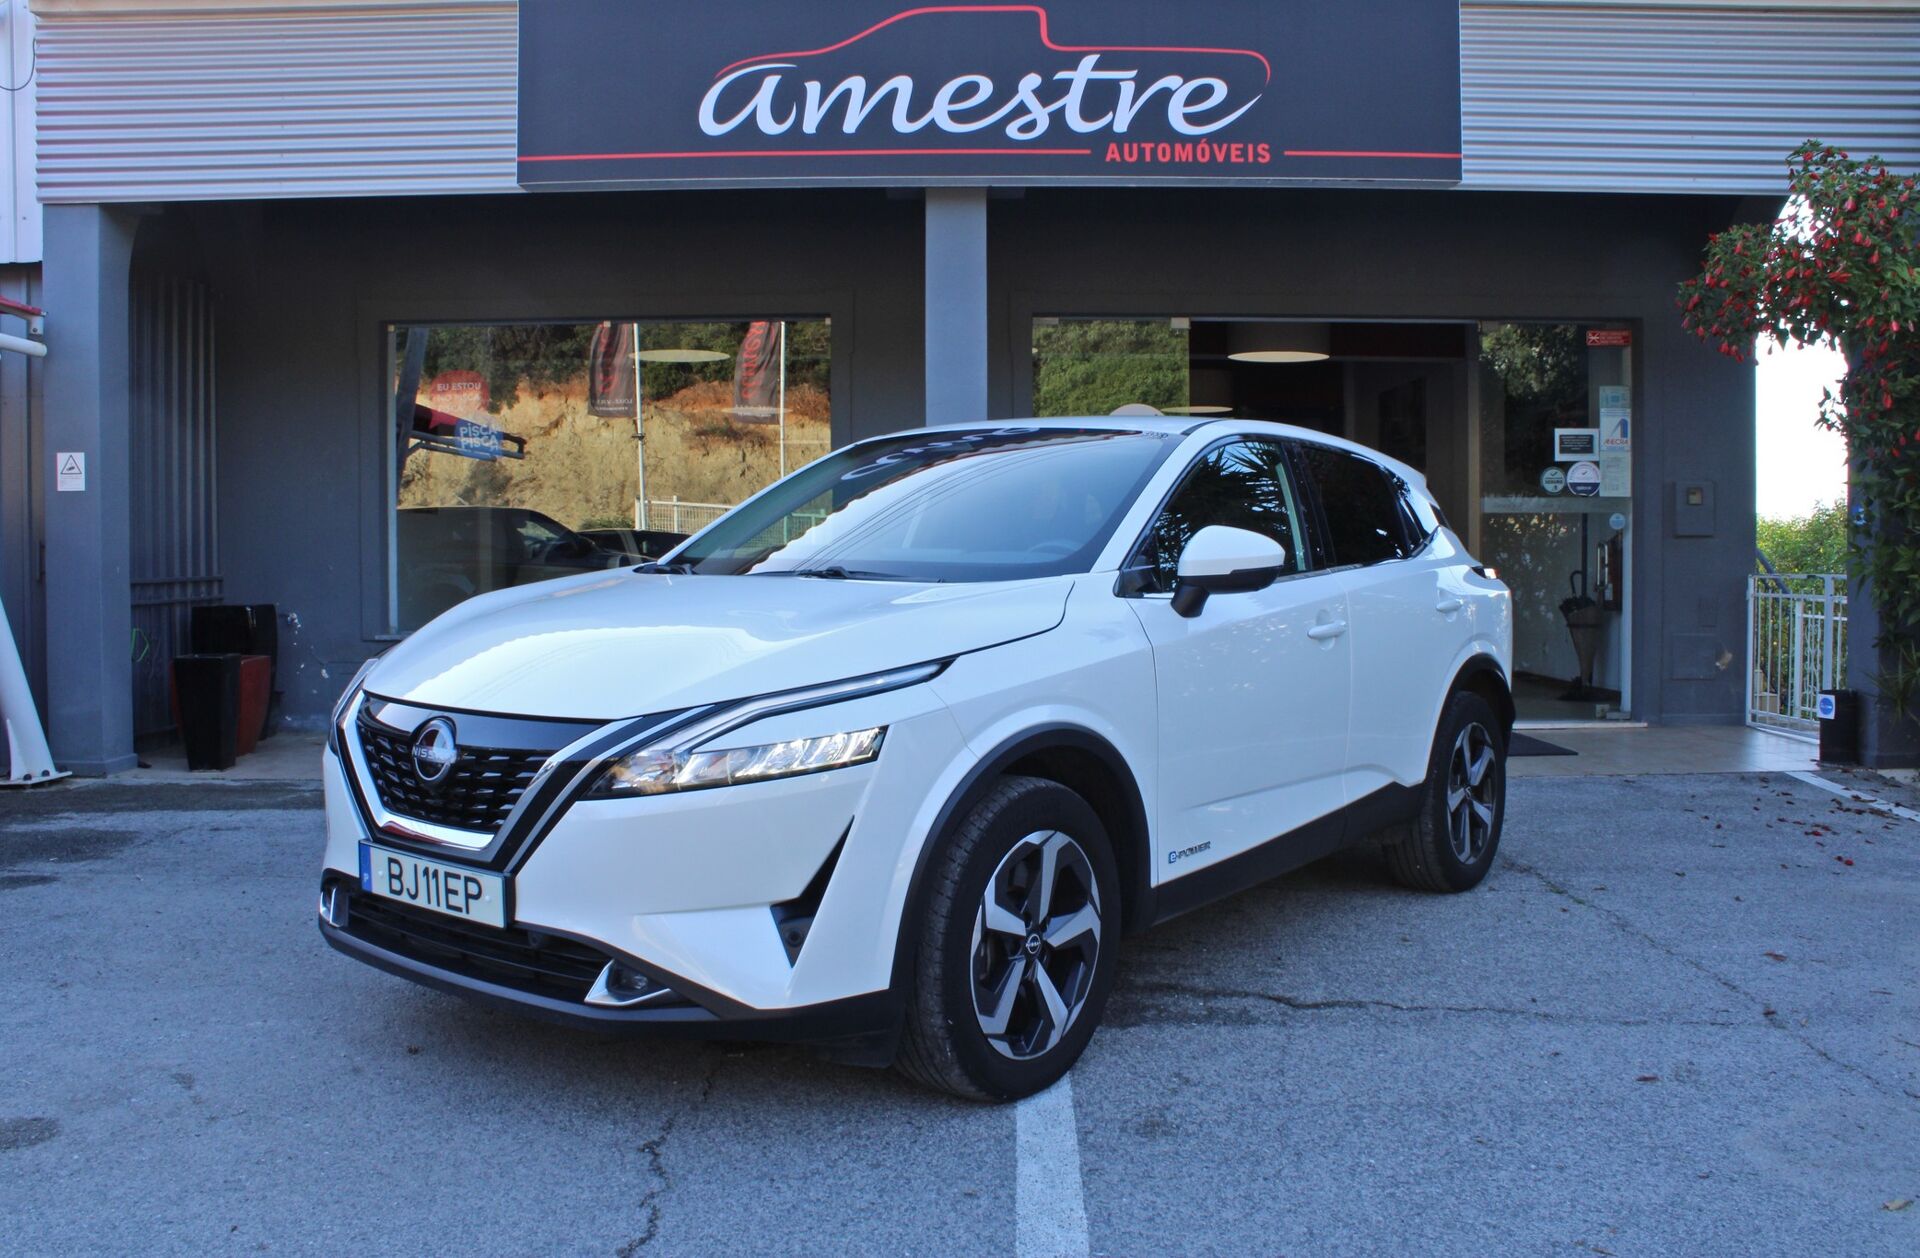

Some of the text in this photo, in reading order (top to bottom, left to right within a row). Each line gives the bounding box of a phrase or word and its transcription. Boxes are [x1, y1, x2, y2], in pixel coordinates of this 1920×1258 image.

[698, 53, 1262, 141] amestre
[1105, 139, 1271, 164] AUTOMÓVEIS
[388, 857, 483, 915] BJ11EP
